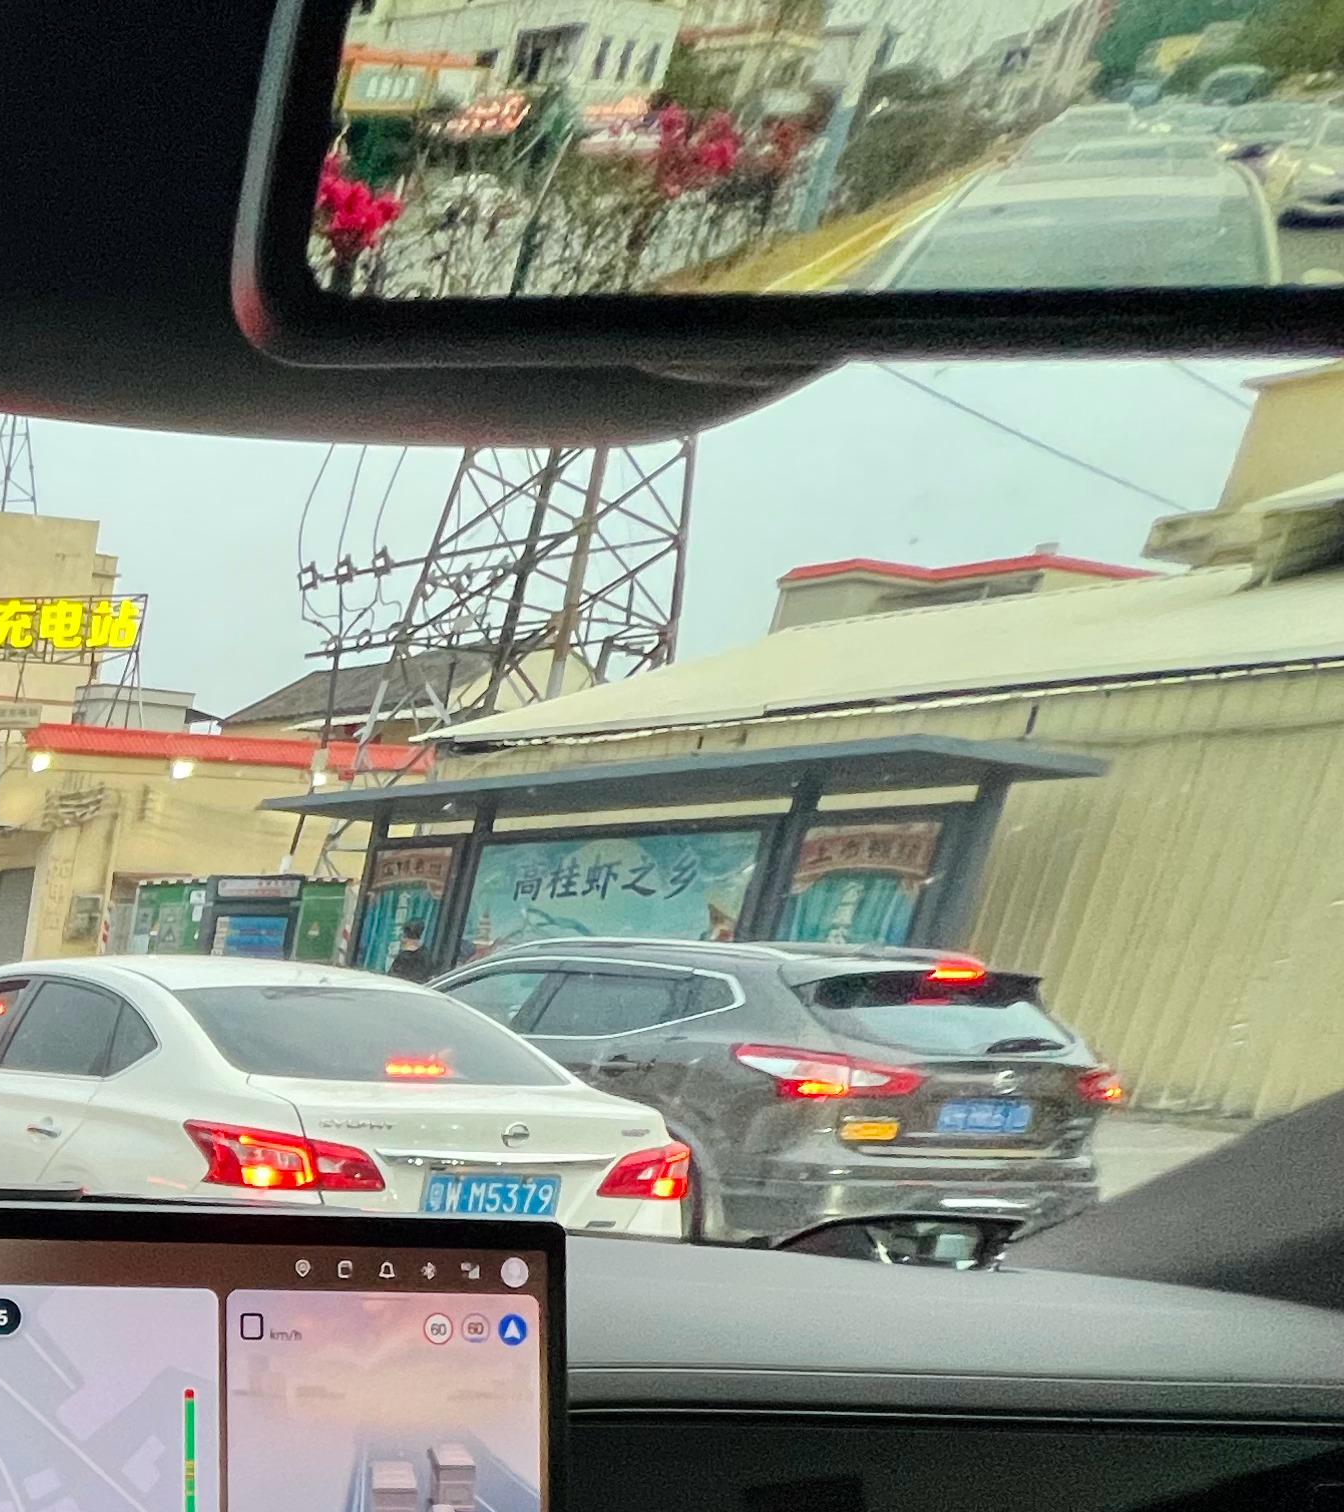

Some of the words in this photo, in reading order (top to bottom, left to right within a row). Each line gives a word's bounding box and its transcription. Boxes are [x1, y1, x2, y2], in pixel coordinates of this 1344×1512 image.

[513, 852, 698, 901] 高桂虾之乡
[430, 1322, 447, 1335] 60
[269, 1329, 302, 1342] km/h
